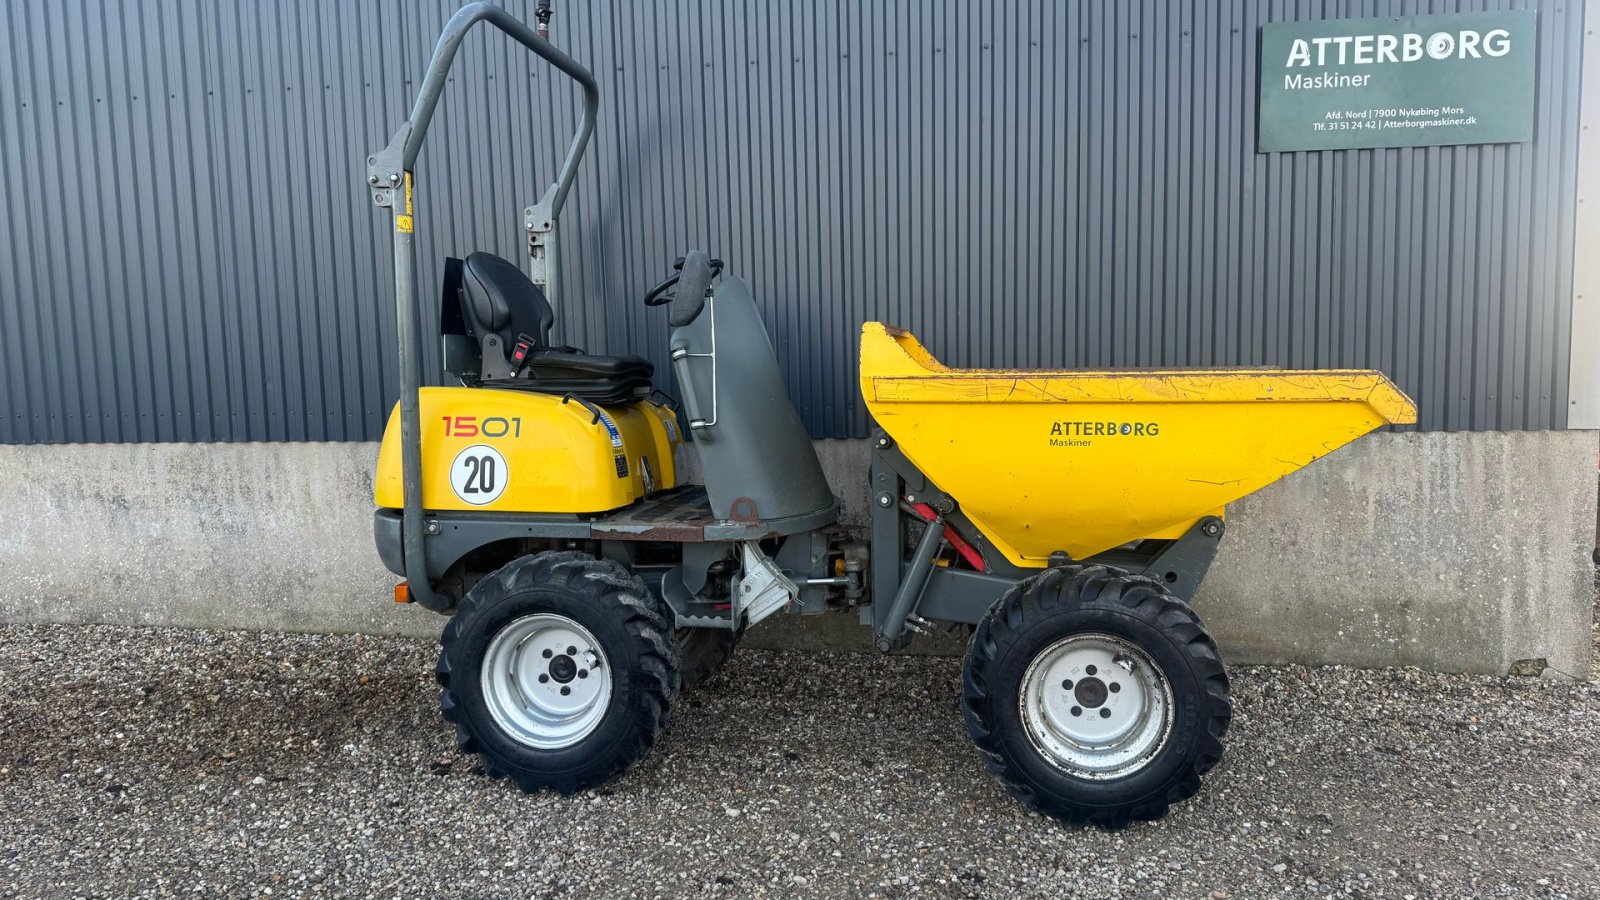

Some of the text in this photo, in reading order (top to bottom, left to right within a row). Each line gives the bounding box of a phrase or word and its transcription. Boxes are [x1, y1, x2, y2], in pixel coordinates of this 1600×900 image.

[1285, 28, 1511, 68] ATTERBORG
[1284, 72, 1371, 90] Maskiner
[1325, 111, 1343, 120] Afd.
[1346, 110, 1367, 119] Nord
[1374, 109, 1397, 118] 7900
[1399, 107, 1440, 118] Nykøbing
[1441, 106, 1465, 115] Mors
[1328, 122, 1338, 130] 31
[1340, 122, 1350, 130] 51
[1352, 121, 1363, 130] 24
[1365, 120, 1376, 129] 42
[1383, 116, 1477, 129] Atterborgmaskiner.dk
[442, 416, 522, 438] 1501
[1050, 421, 1159, 436] ATTERBORG
[1049, 438, 1092, 447] Maskiner
[463, 455, 496, 494] 20
